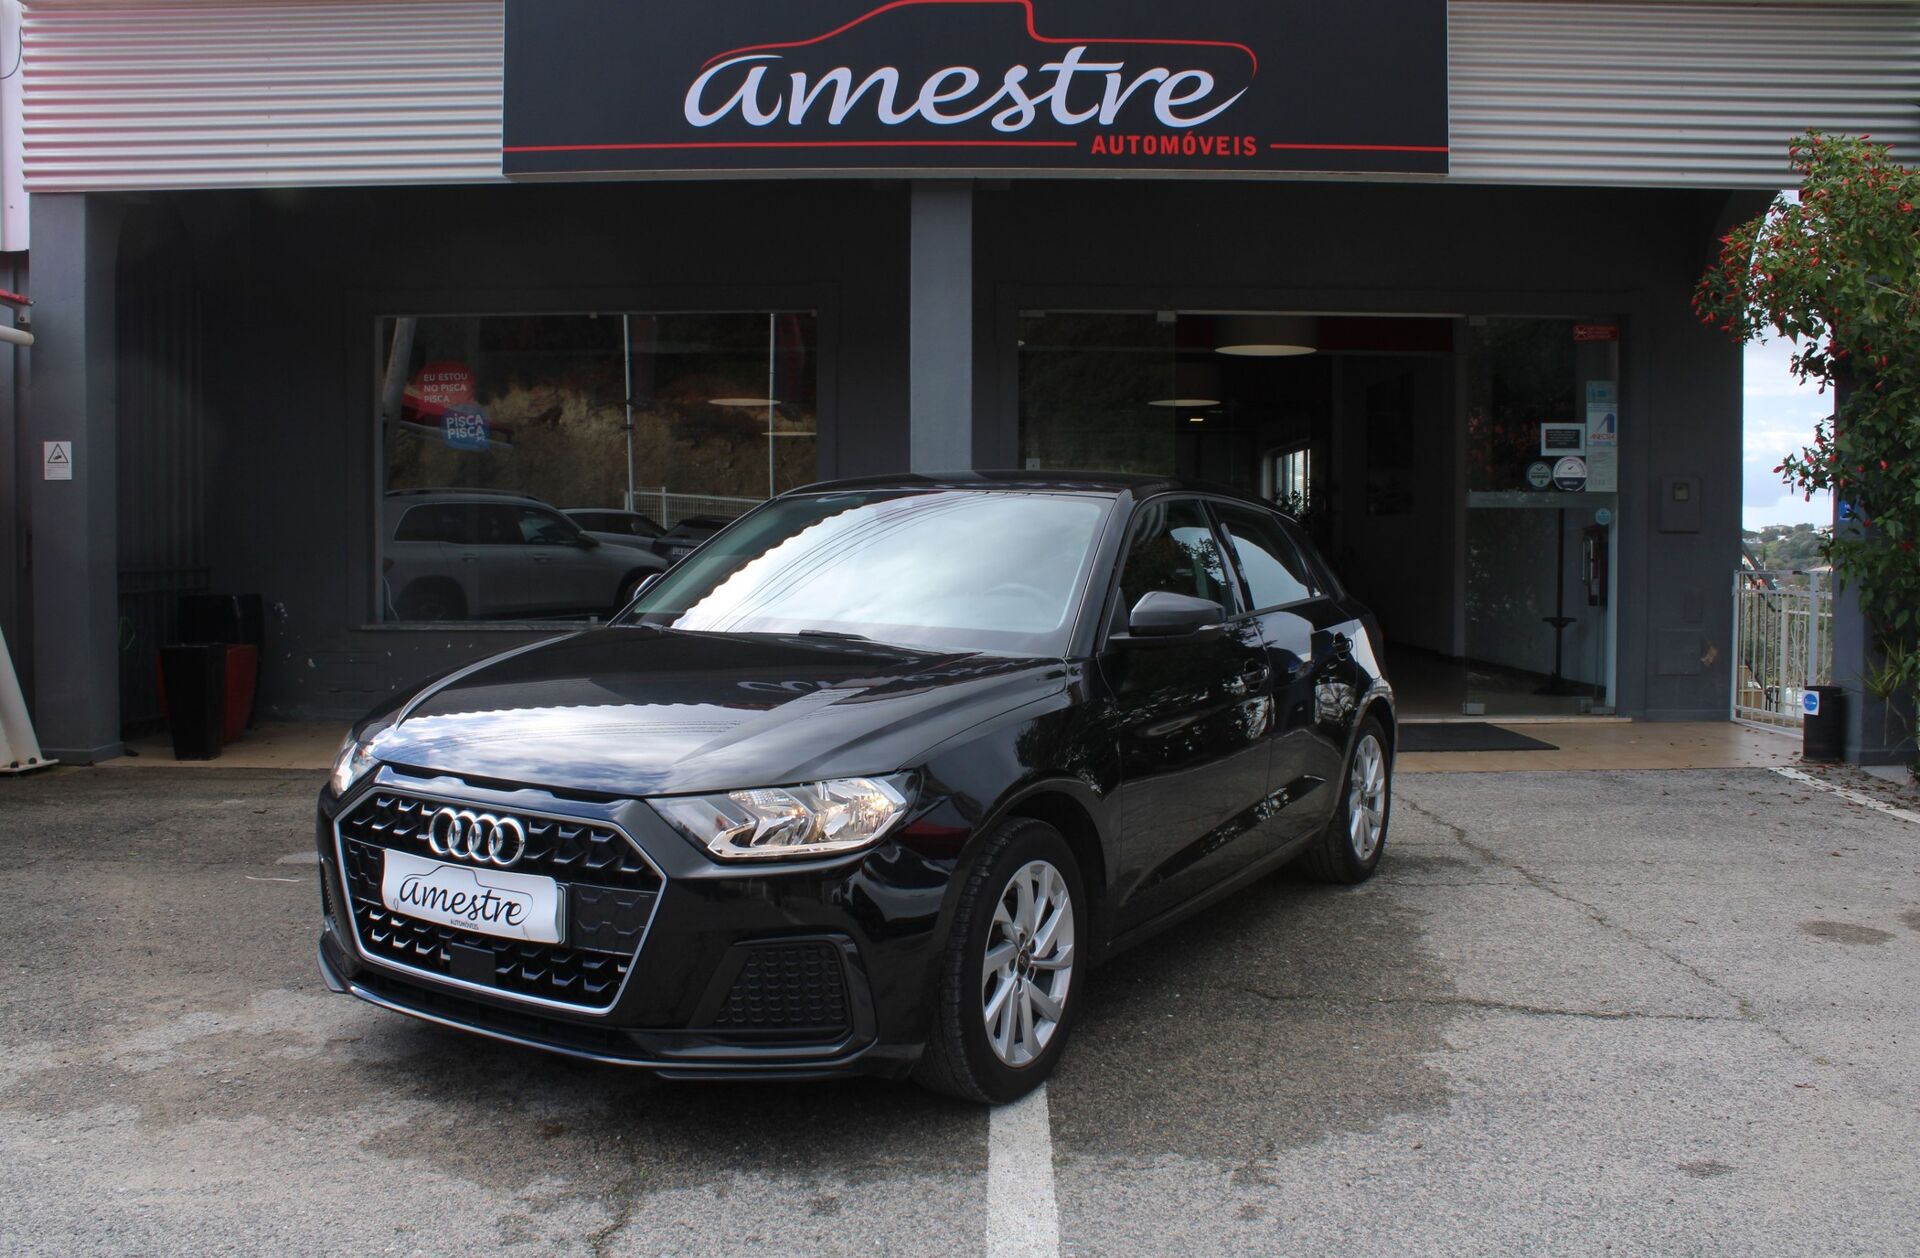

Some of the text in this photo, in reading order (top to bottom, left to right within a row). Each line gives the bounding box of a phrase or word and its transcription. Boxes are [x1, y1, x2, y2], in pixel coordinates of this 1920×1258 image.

[684, 46, 1248, 132] amestre
[1091, 131, 1257, 156] AUTOMÓVEIS
[424, 372, 468, 382] EU ESTOU
[424, 383, 467, 392] NO PISCA
[424, 395, 450, 403] PISCA
[399, 876, 527, 926] amestre
